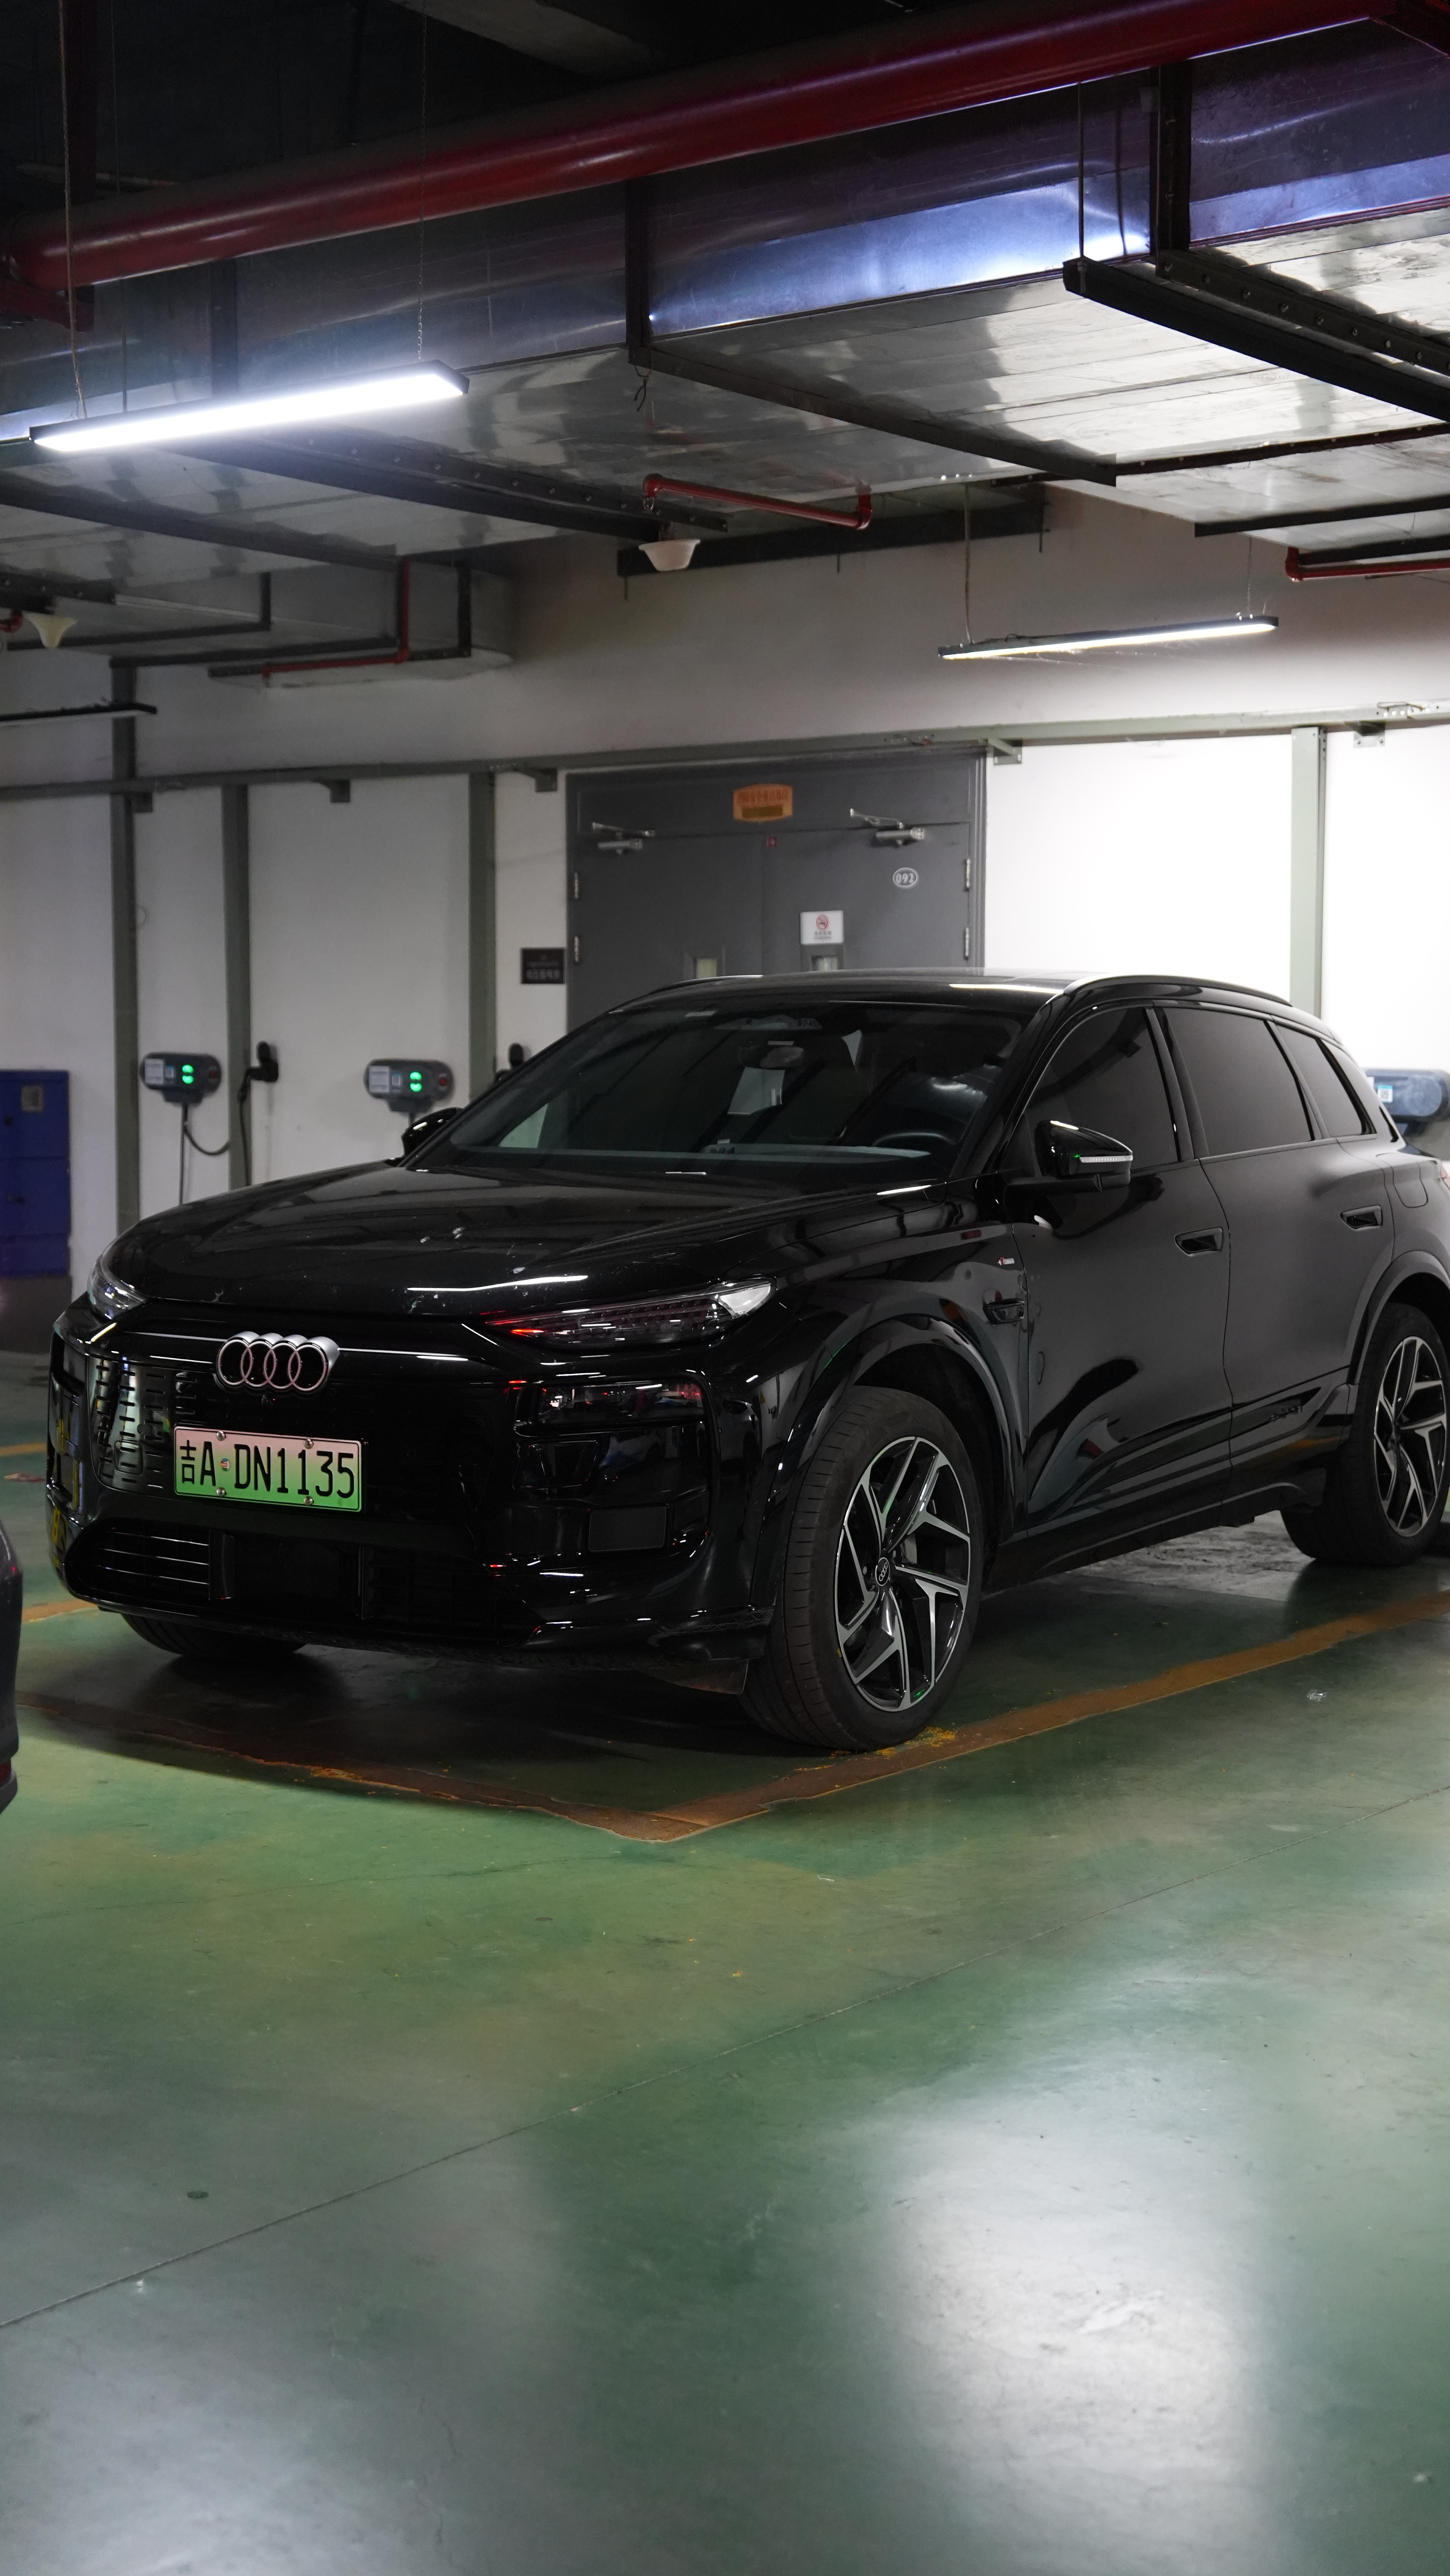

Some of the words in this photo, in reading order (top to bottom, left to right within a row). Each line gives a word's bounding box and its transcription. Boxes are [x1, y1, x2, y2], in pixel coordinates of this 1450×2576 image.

[896, 873, 914, 884] 092
[180, 1440, 216, 1486] 吉A
[234, 1444, 354, 1498] DN1135
